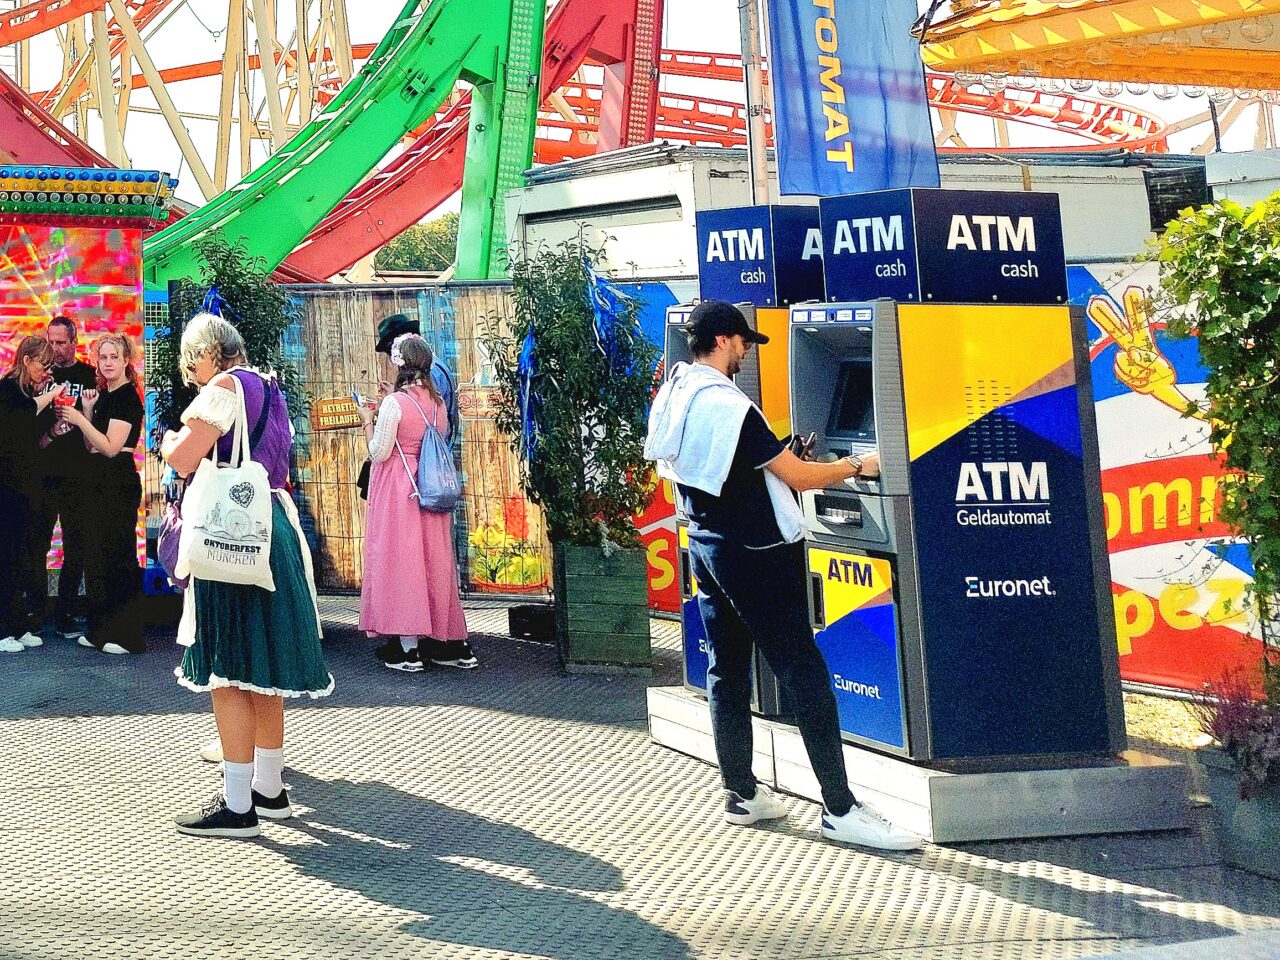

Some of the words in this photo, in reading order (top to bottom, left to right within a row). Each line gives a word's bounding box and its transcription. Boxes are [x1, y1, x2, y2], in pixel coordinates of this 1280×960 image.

[706, 227, 765, 263] ATM
[833, 214, 904, 255] ATM
[947, 214, 1037, 252] ATM
[740, 267, 766, 284] cash
[875, 258, 907, 278] cash
[1001, 259, 1039, 278] cash
[955, 461, 1051, 502] ATM
[956, 509, 1052, 526] Geldautomat
[204, 538, 262, 554] OKTOBERFEST
[827, 557, 873, 589] ATM
[965, 576, 1052, 598] Euronet
[833, 673, 881, 700] Euronet
